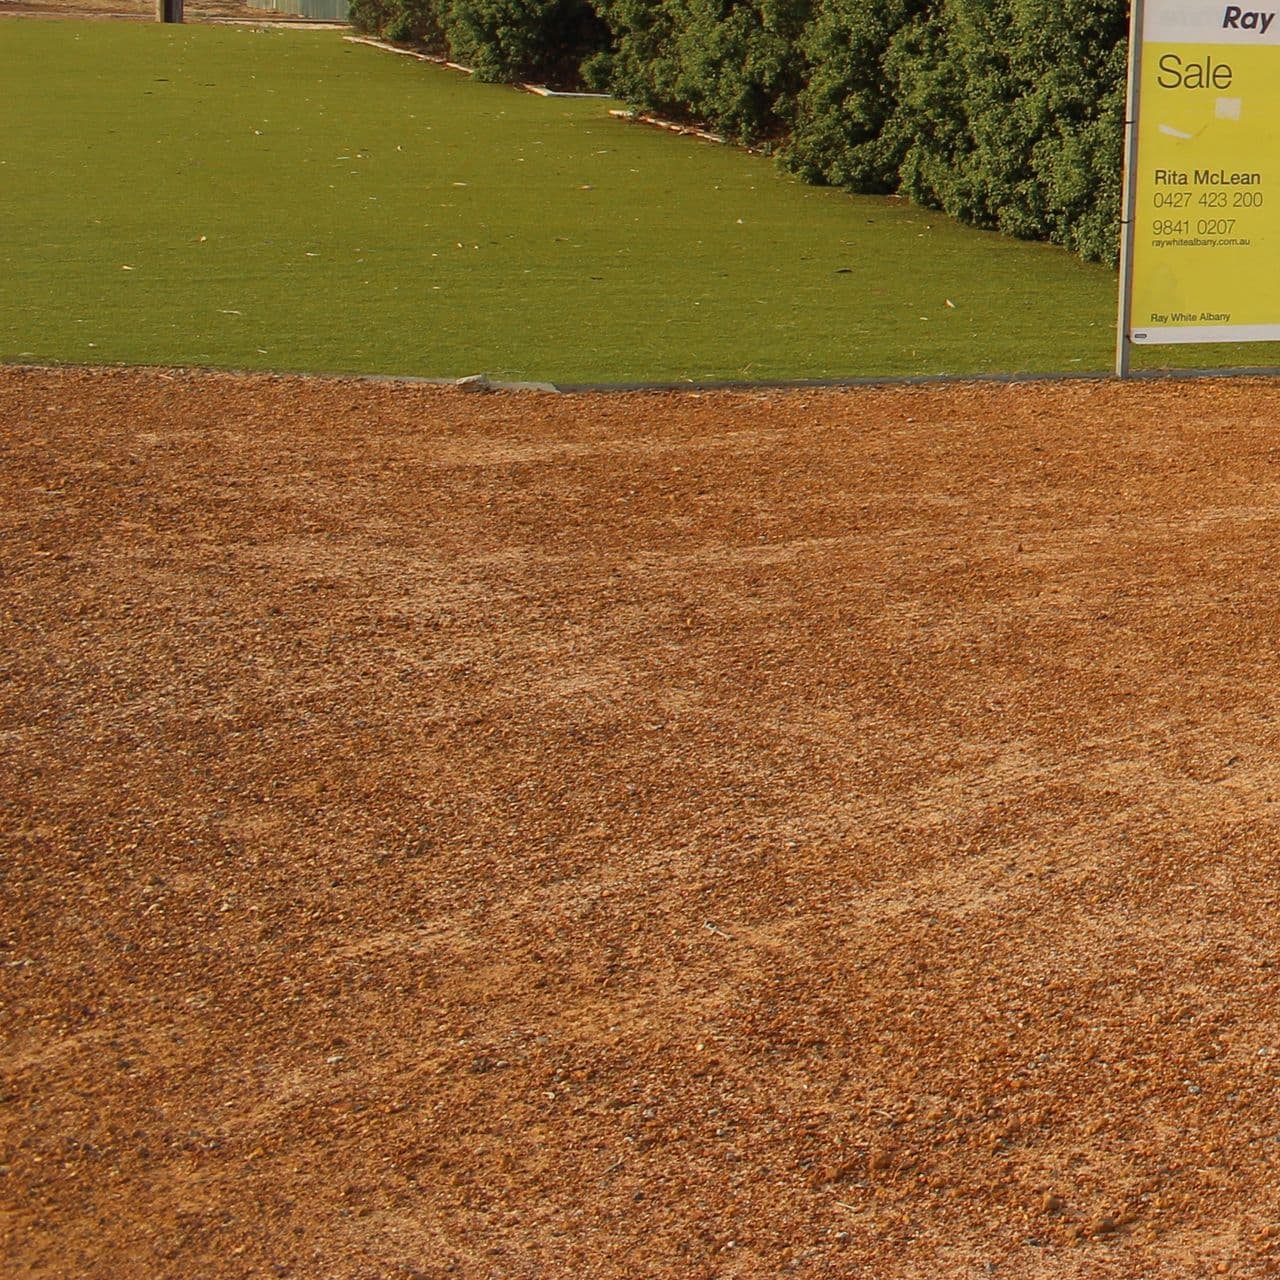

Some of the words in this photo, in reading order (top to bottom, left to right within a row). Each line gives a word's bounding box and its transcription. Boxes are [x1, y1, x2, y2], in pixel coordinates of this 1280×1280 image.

[1223, 6, 1275, 34] Ray
[1157, 54, 1232, 89] Sale
[1155, 170, 1187, 185] Rita
[1194, 170, 1261, 185] McLean
[1153, 193, 1191, 208] 0427
[1198, 192, 1228, 208] 423
[1233, 192, 1263, 208] 200
[1152, 219, 1189, 236] 9841
[1197, 219, 1236, 235] 0207
[1151, 237, 1250, 248] raywhitealbany.com.au
[1150, 313, 1168, 323] Ray
[1171, 313, 1197, 322] White
[1200, 312, 1230, 322] Albany
